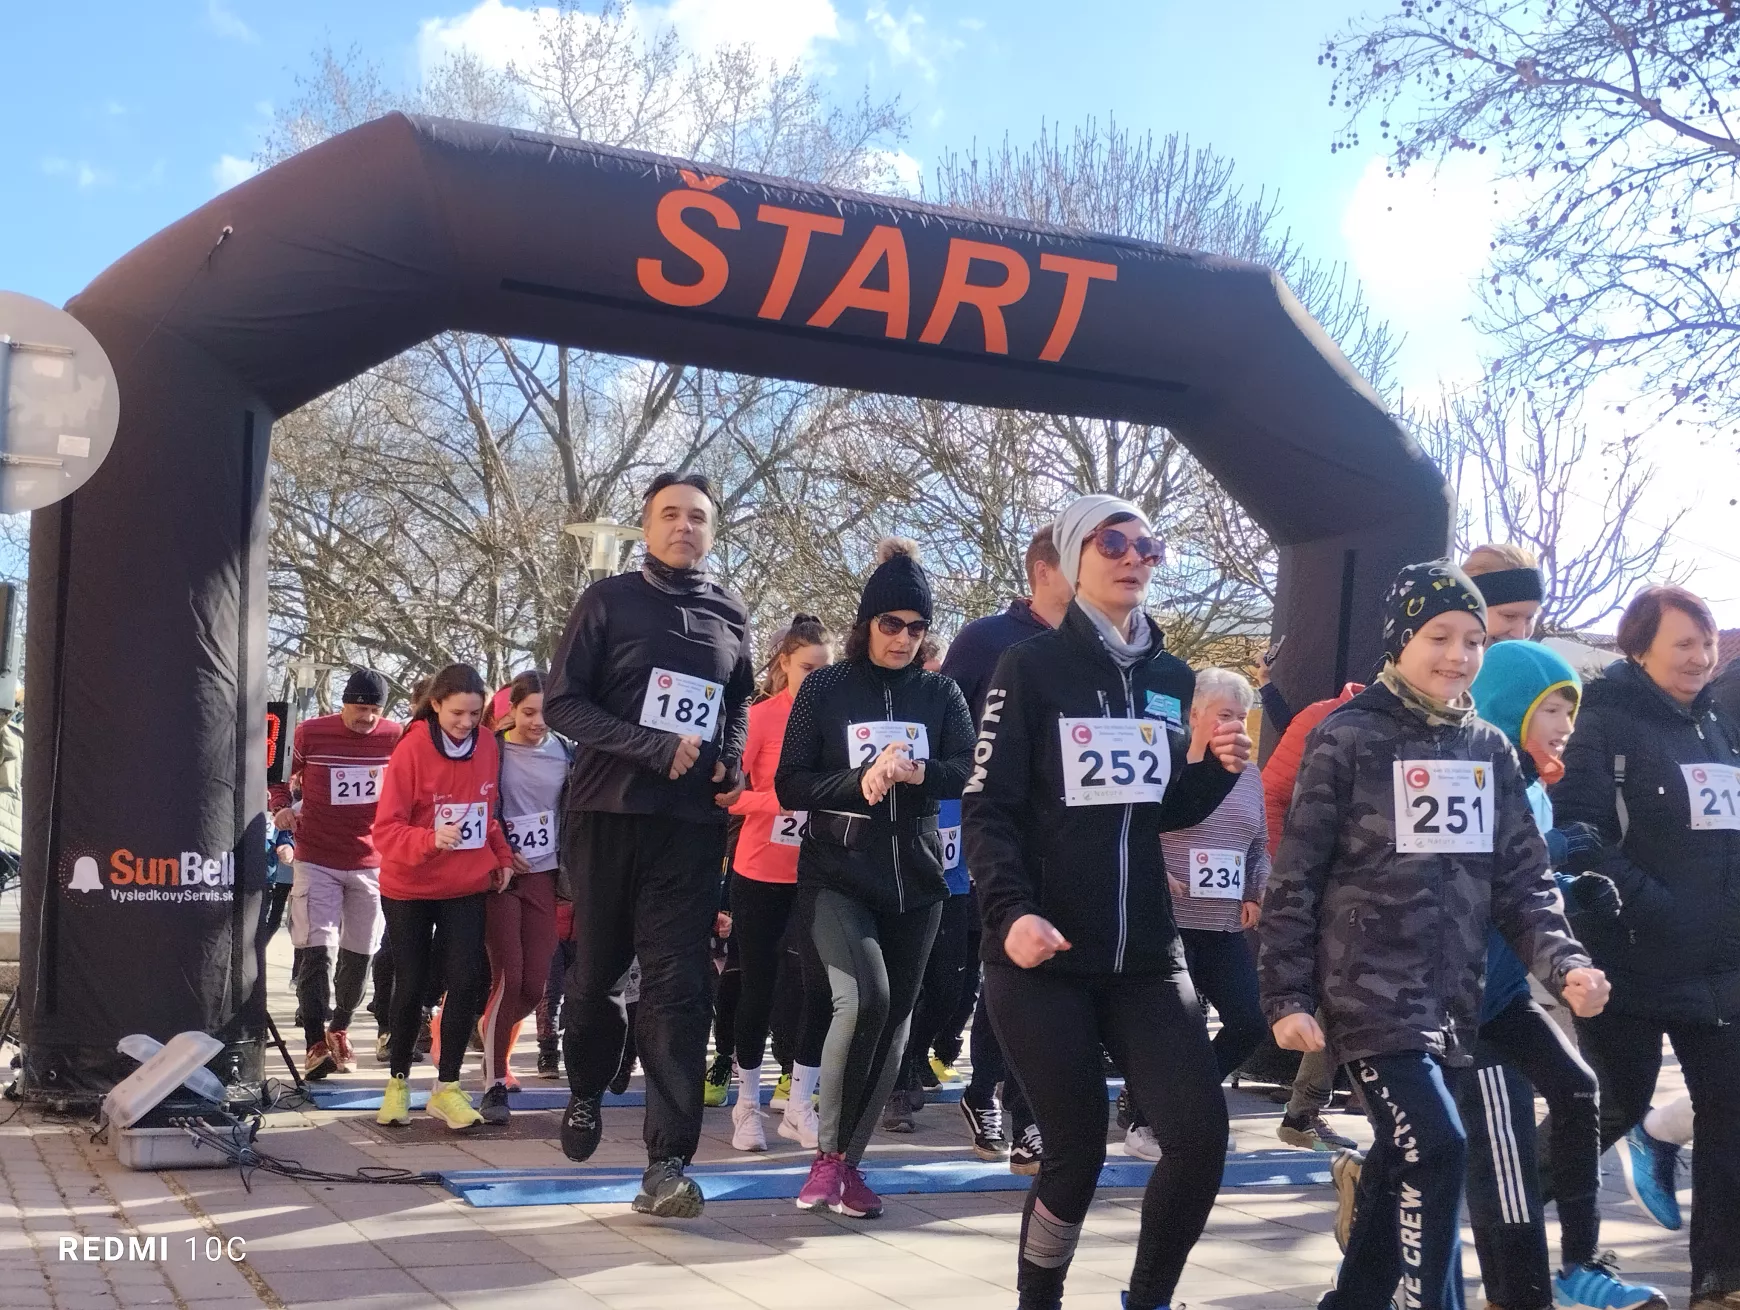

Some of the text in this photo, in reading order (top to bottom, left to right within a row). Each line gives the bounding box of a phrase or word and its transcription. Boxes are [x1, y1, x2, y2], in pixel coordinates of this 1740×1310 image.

[637, 169, 1117, 362] ŠTART
[657, 693, 710, 728] 182
[860, 743, 914, 765] 21
[1078, 750, 1162, 787] 252
[338, 781, 376, 797] 212
[1412, 795, 1483, 834] 251
[1700, 788, 1740, 816] 21
[445, 820, 482, 841] 61
[509, 828, 549, 849] 243
[781, 817, 808, 838] 26
[110, 848, 235, 887] SunBell
[1198, 867, 1240, 889] 234
[110, 889, 234, 904] VysledkovyServis.sk
[1400, 1181, 1422, 1267] CREW
